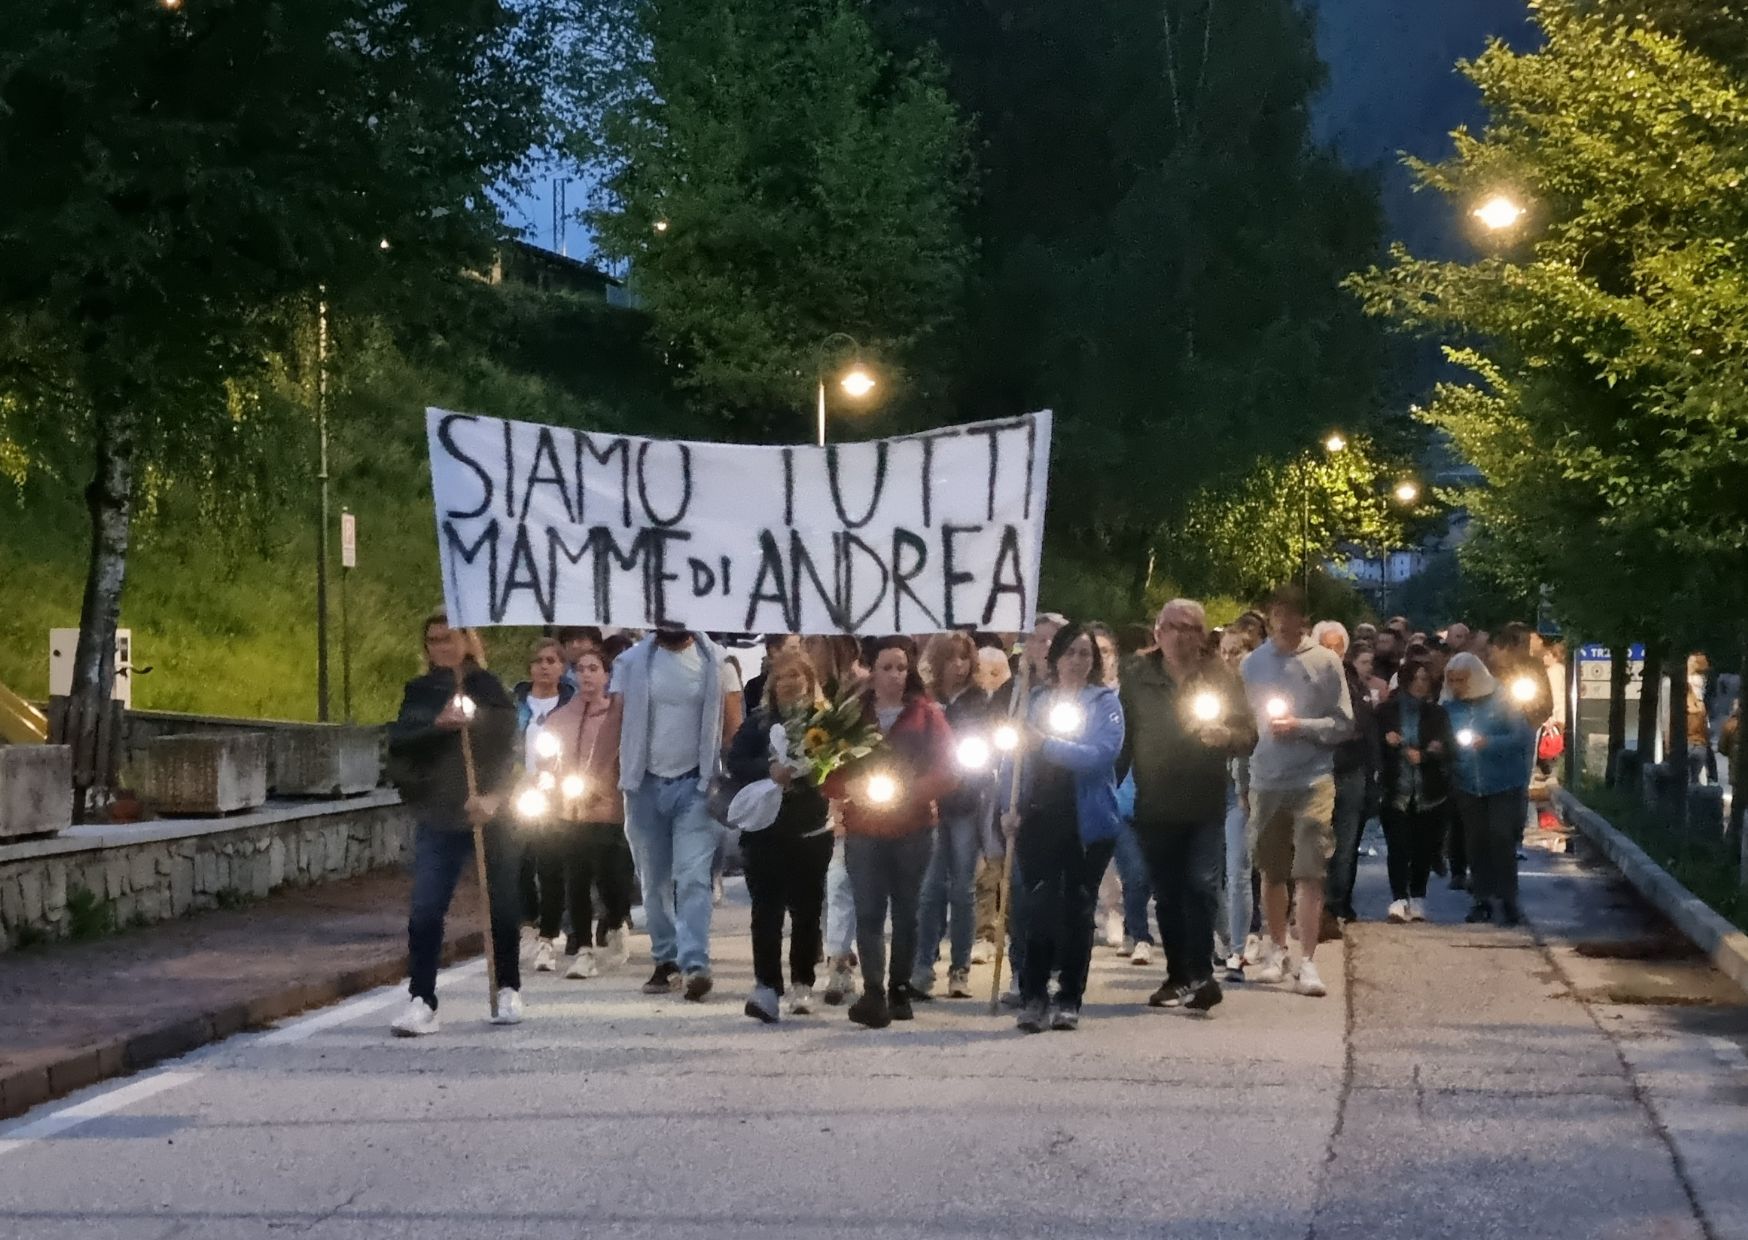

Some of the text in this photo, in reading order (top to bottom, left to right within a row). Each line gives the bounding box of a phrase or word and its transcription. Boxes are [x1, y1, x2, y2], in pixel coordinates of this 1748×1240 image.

[441, 518, 1026, 633] MAMME DI ANDREA
